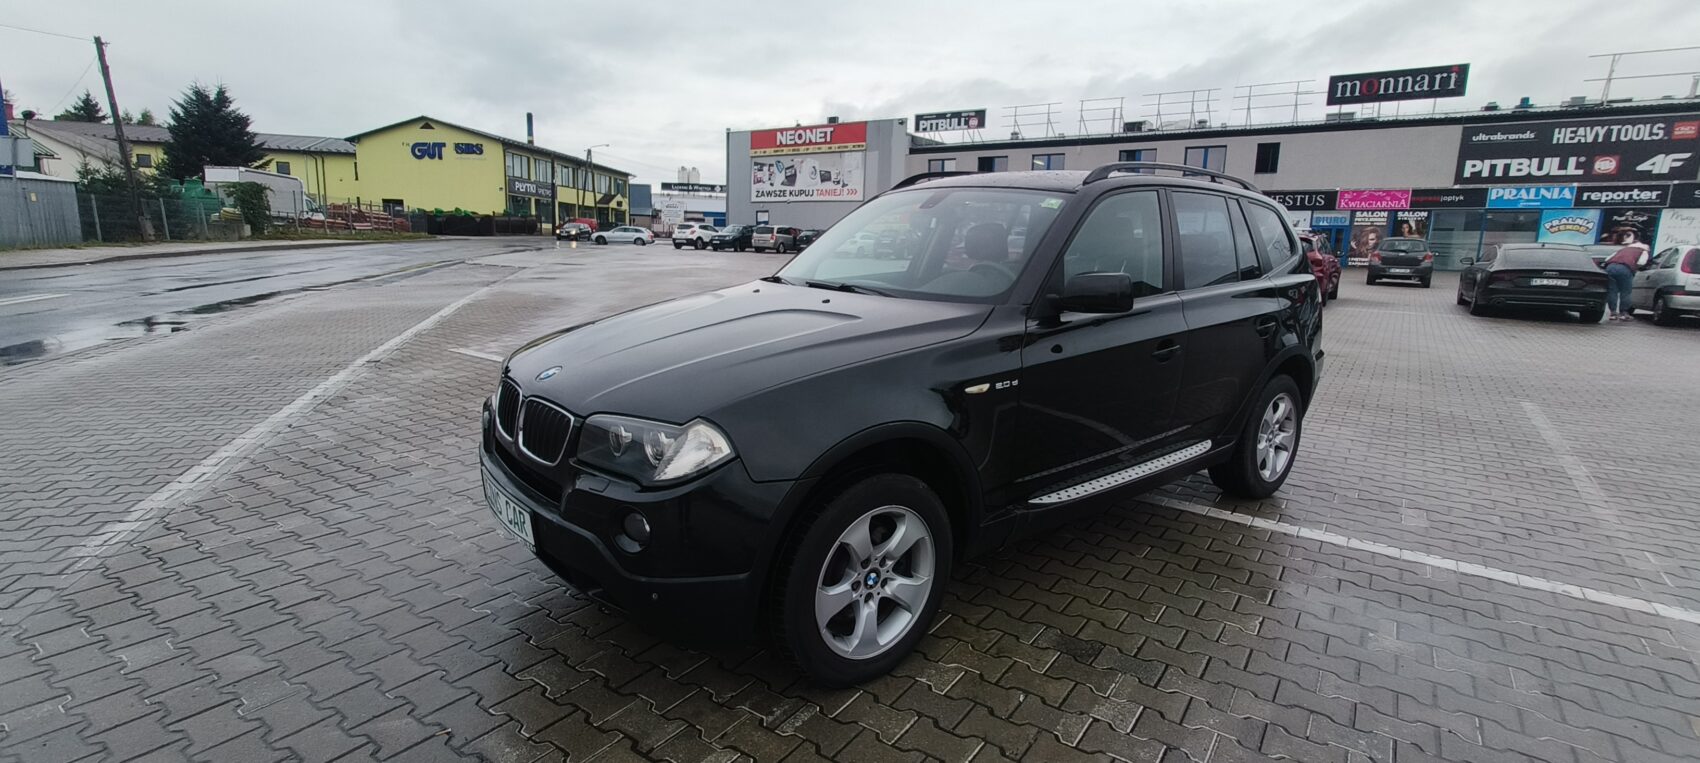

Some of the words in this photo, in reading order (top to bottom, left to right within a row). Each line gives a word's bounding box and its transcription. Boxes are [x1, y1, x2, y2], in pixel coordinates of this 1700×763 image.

[1335, 65, 1459, 98] monnari
[919, 117, 968, 132] PITBULL
[776, 127, 834, 146] NEONET
[1472, 131, 1536, 142] ultrabrands
[1552, 125, 1608, 144] HEAVY
[1610, 123, 1666, 142] TOOLS
[411, 141, 447, 160] GUT
[1463, 156, 1584, 178] PITBULL
[1635, 152, 1693, 175] 4F
[755, 189, 787, 198] ZAWSZE
[788, 189, 815, 197] KUPUJ
[816, 188, 844, 197] TANIEJ!
[1271, 194, 1325, 206] ESTUS
[1490, 186, 1572, 200] PRALNIA
[1582, 188, 1662, 203] reporter
[1315, 216, 1347, 224] BIURO
[1543, 216, 1595, 230] PRALNIA
[505, 500, 529, 538] CAR
